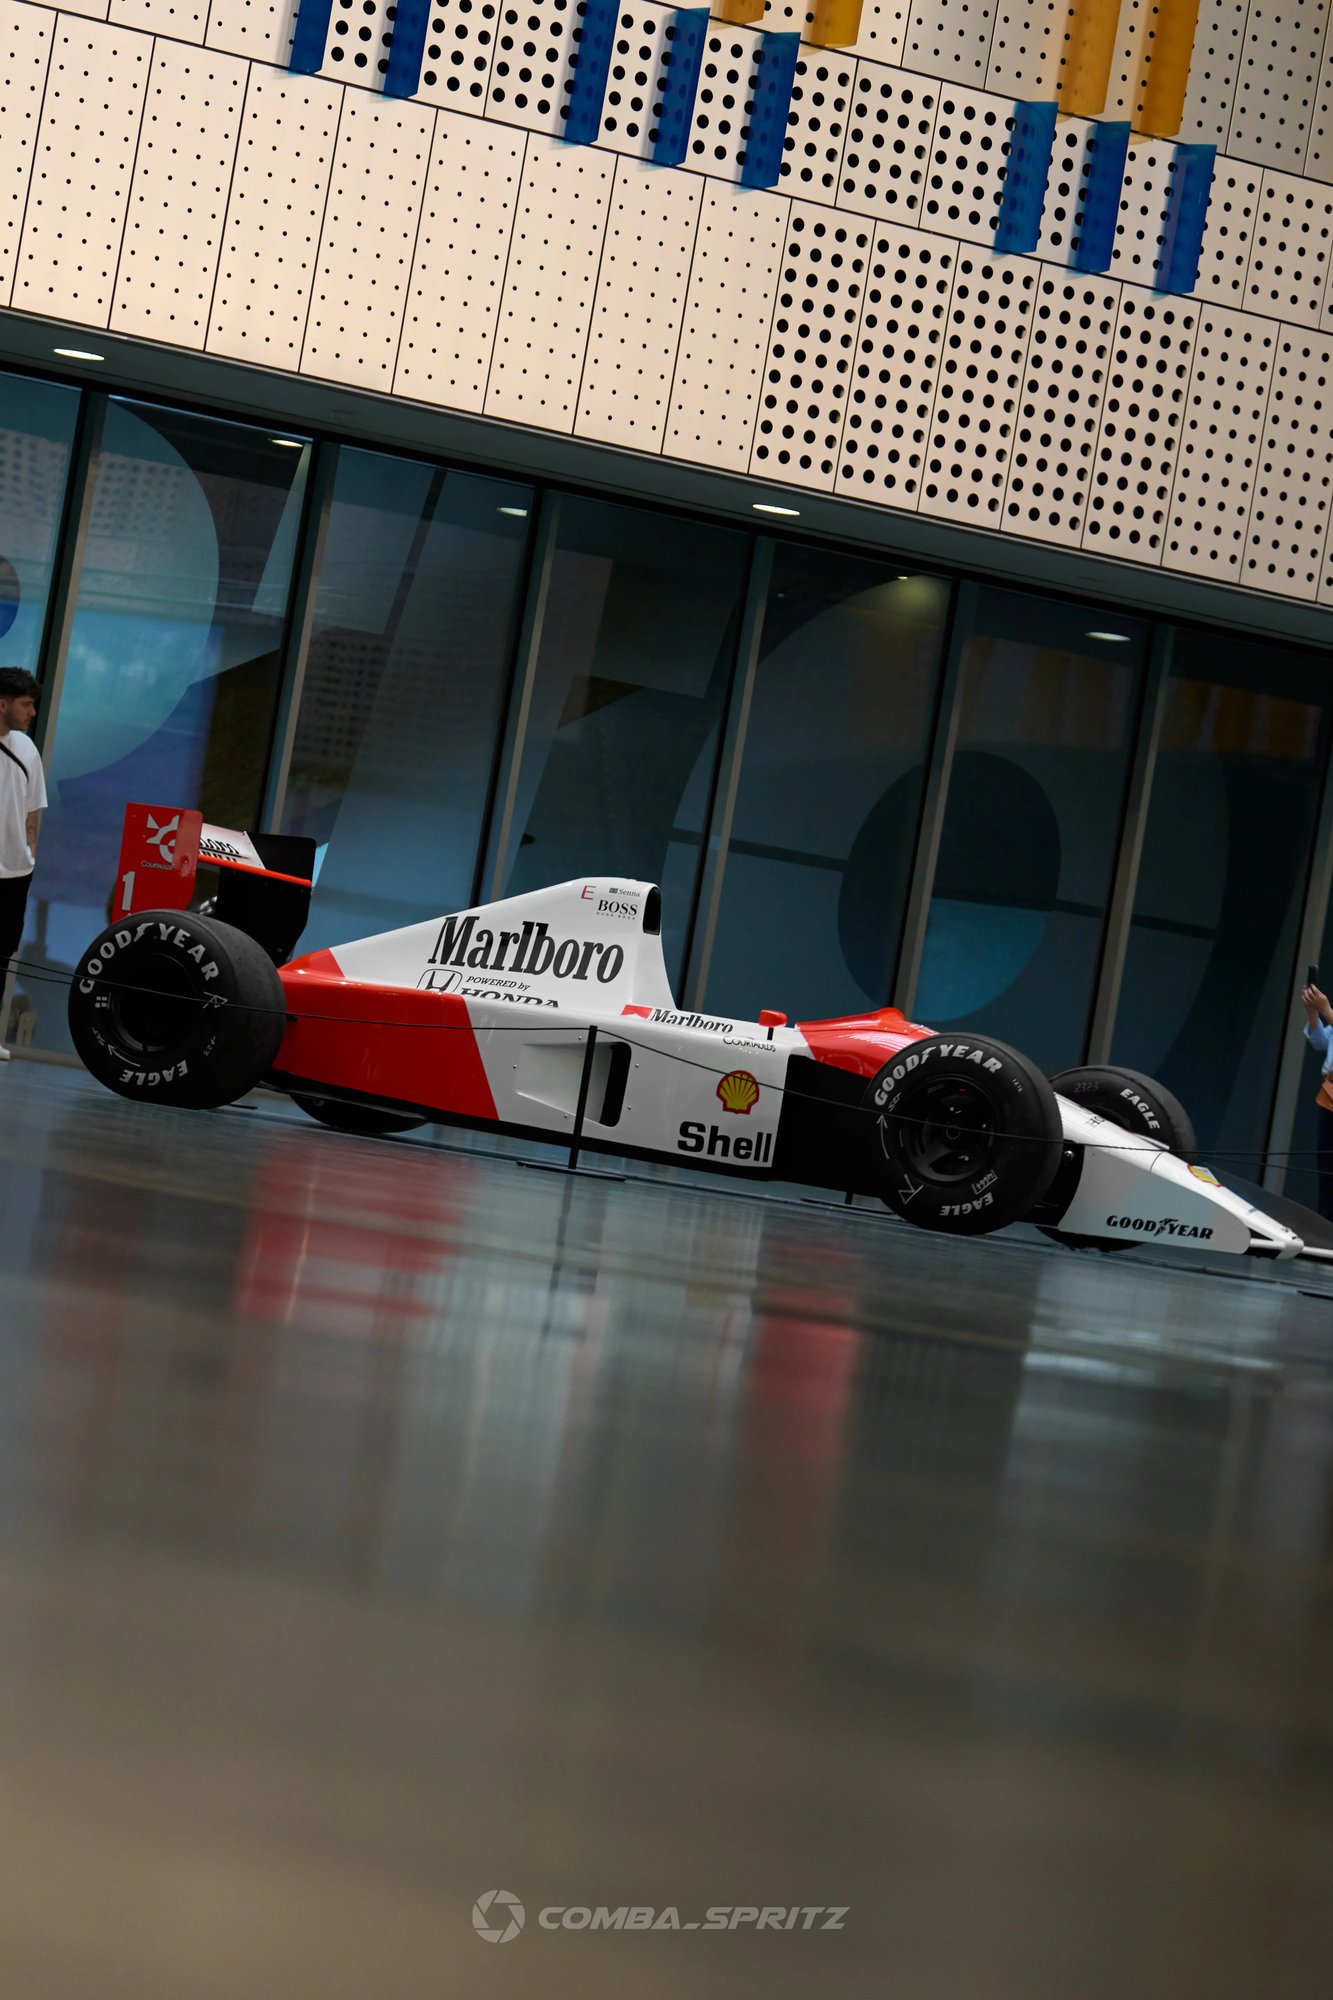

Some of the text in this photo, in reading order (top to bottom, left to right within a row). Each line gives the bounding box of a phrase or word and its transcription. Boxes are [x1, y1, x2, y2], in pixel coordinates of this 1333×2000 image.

[121, 870, 136, 911] 1
[618, 888, 641, 898] Senna
[597, 899, 639, 917] BOSS
[427, 915, 624, 984] Marlboro
[466, 975, 531, 992] POWERED by
[650, 1008, 734, 1034] Marlboro
[118, 1058, 190, 1087] EAGLE
[1118, 1087, 1161, 1131] EAGLE
[677, 1120, 772, 1163] Shell
[938, 1191, 995, 1217] EAGLE
